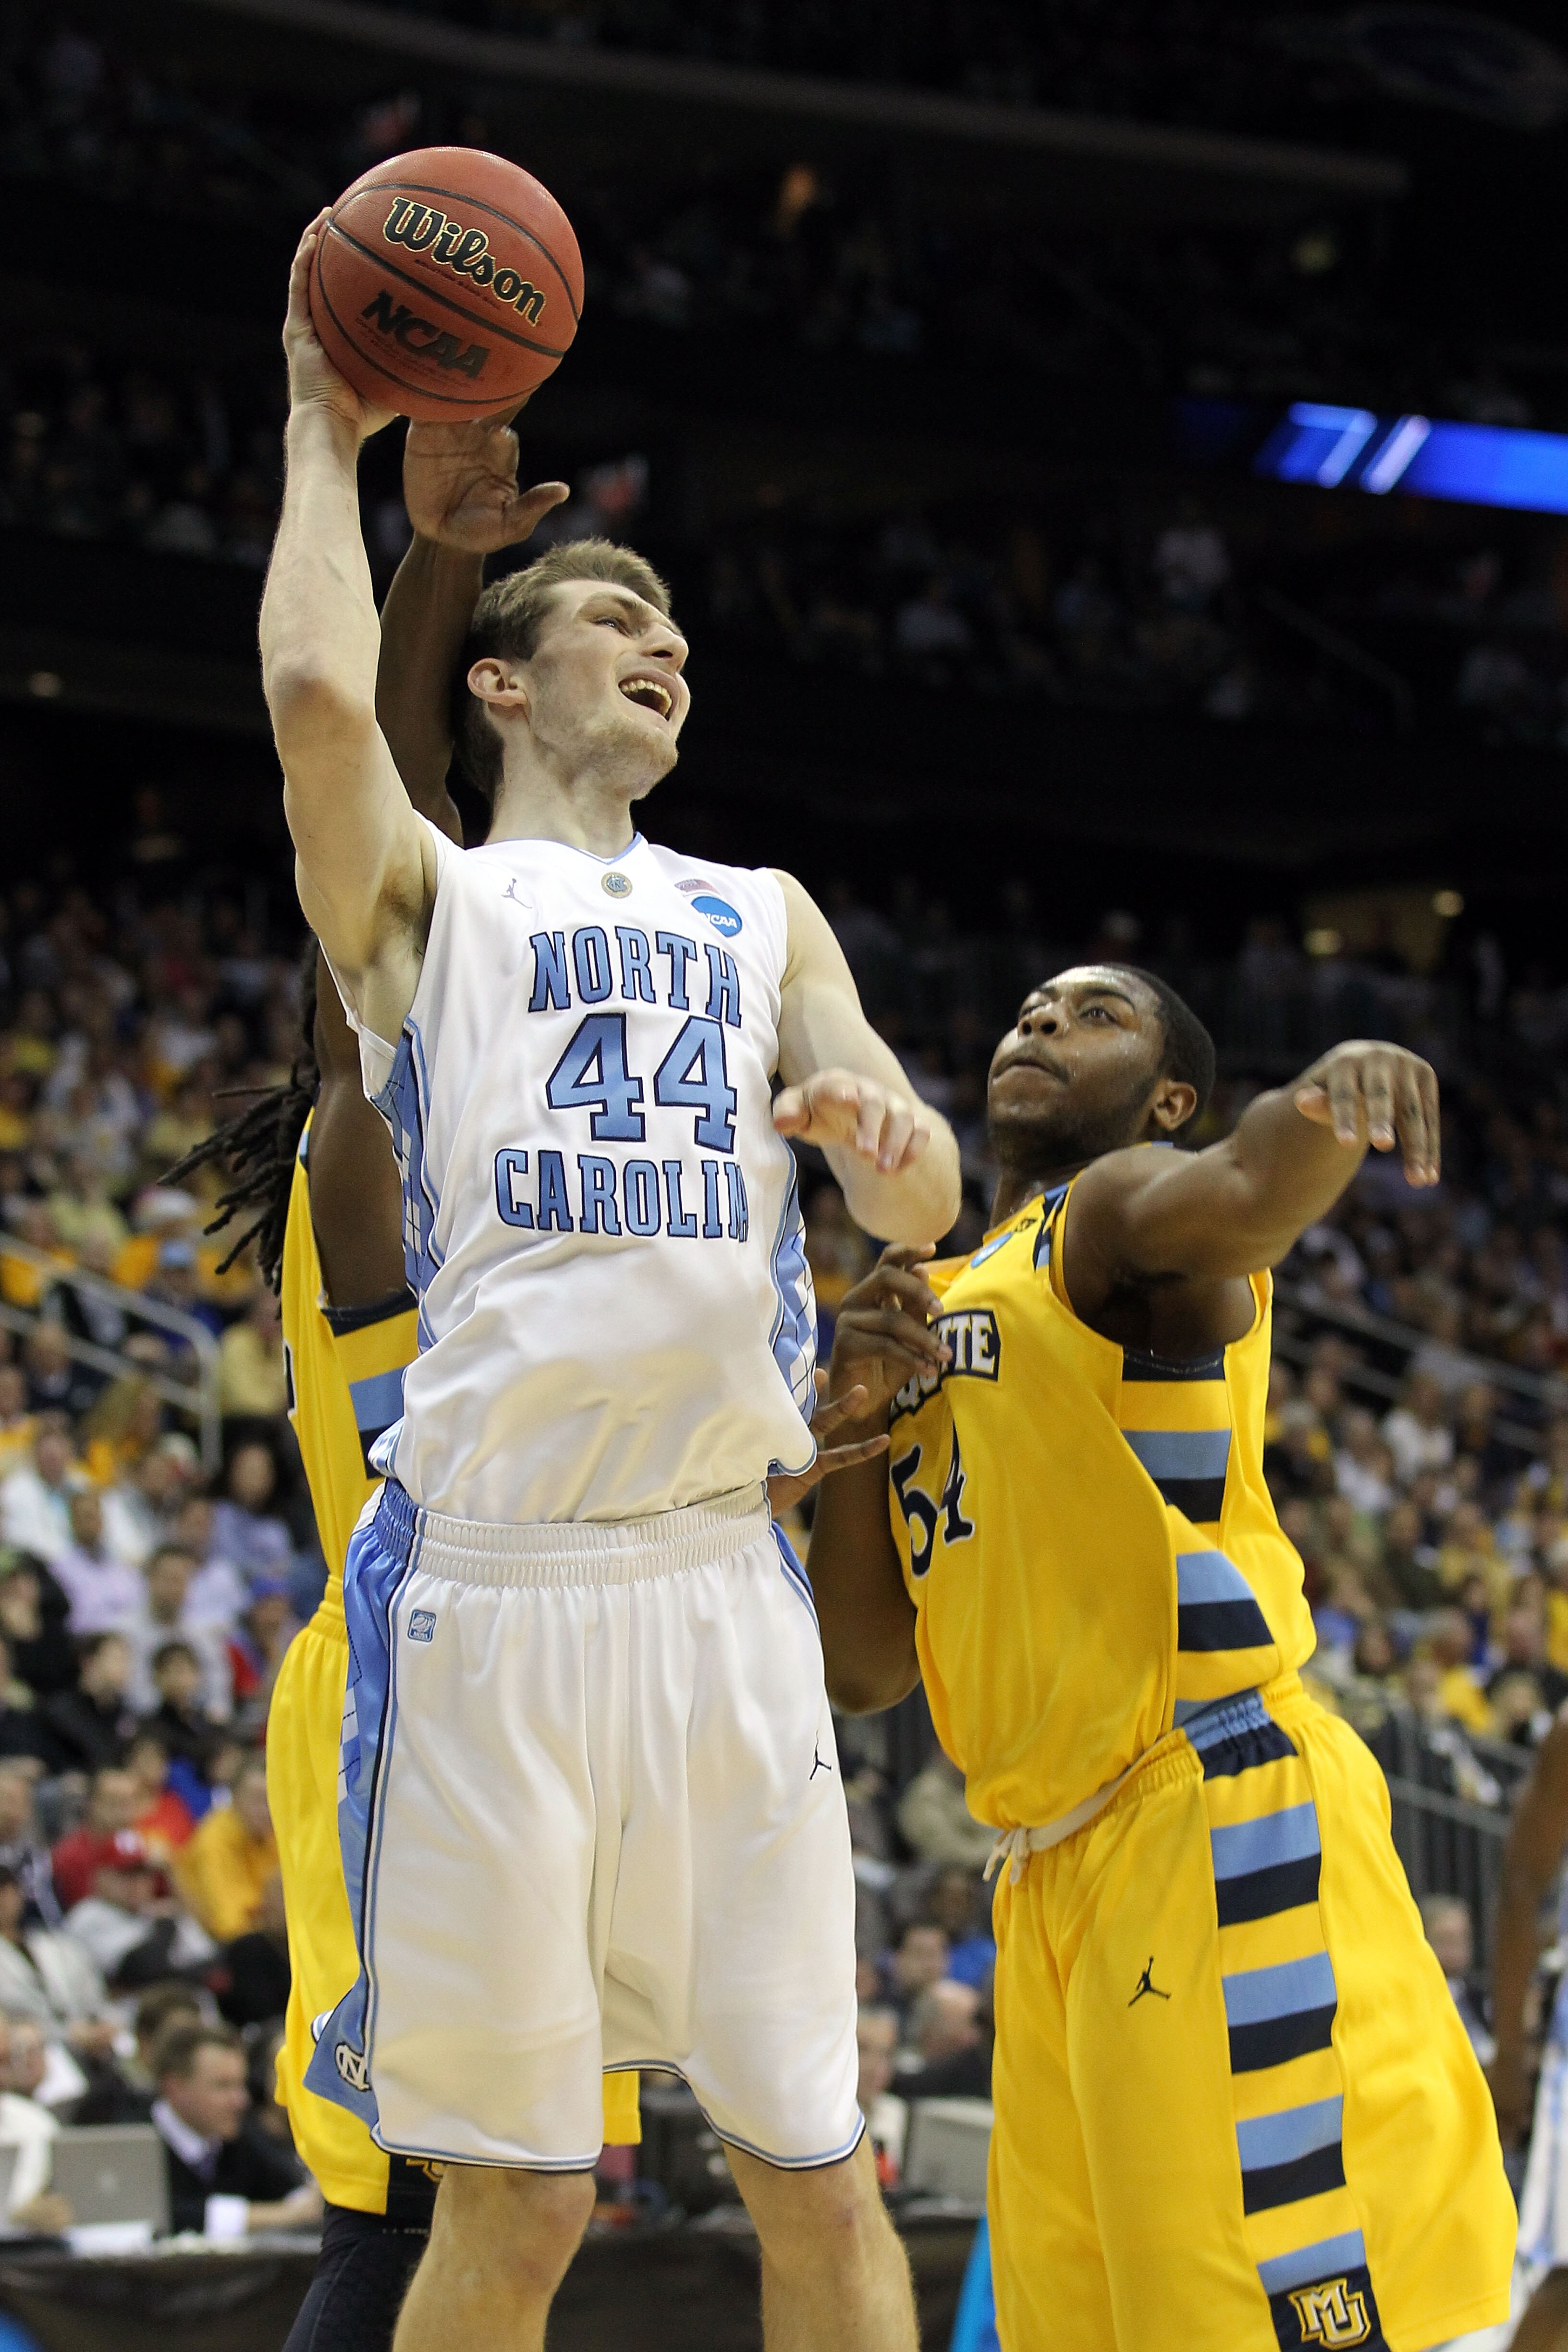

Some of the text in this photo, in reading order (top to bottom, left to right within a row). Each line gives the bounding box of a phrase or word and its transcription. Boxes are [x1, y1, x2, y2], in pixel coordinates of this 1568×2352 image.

[382, 196, 546, 327] Wilson
[362, 290, 490, 378] NCAA
[528, 925, 742, 1029] NORTH
[545, 1012, 737, 1154] 44
[890, 1416, 975, 1580] 54
[1288, 2278, 1372, 2350] MU
